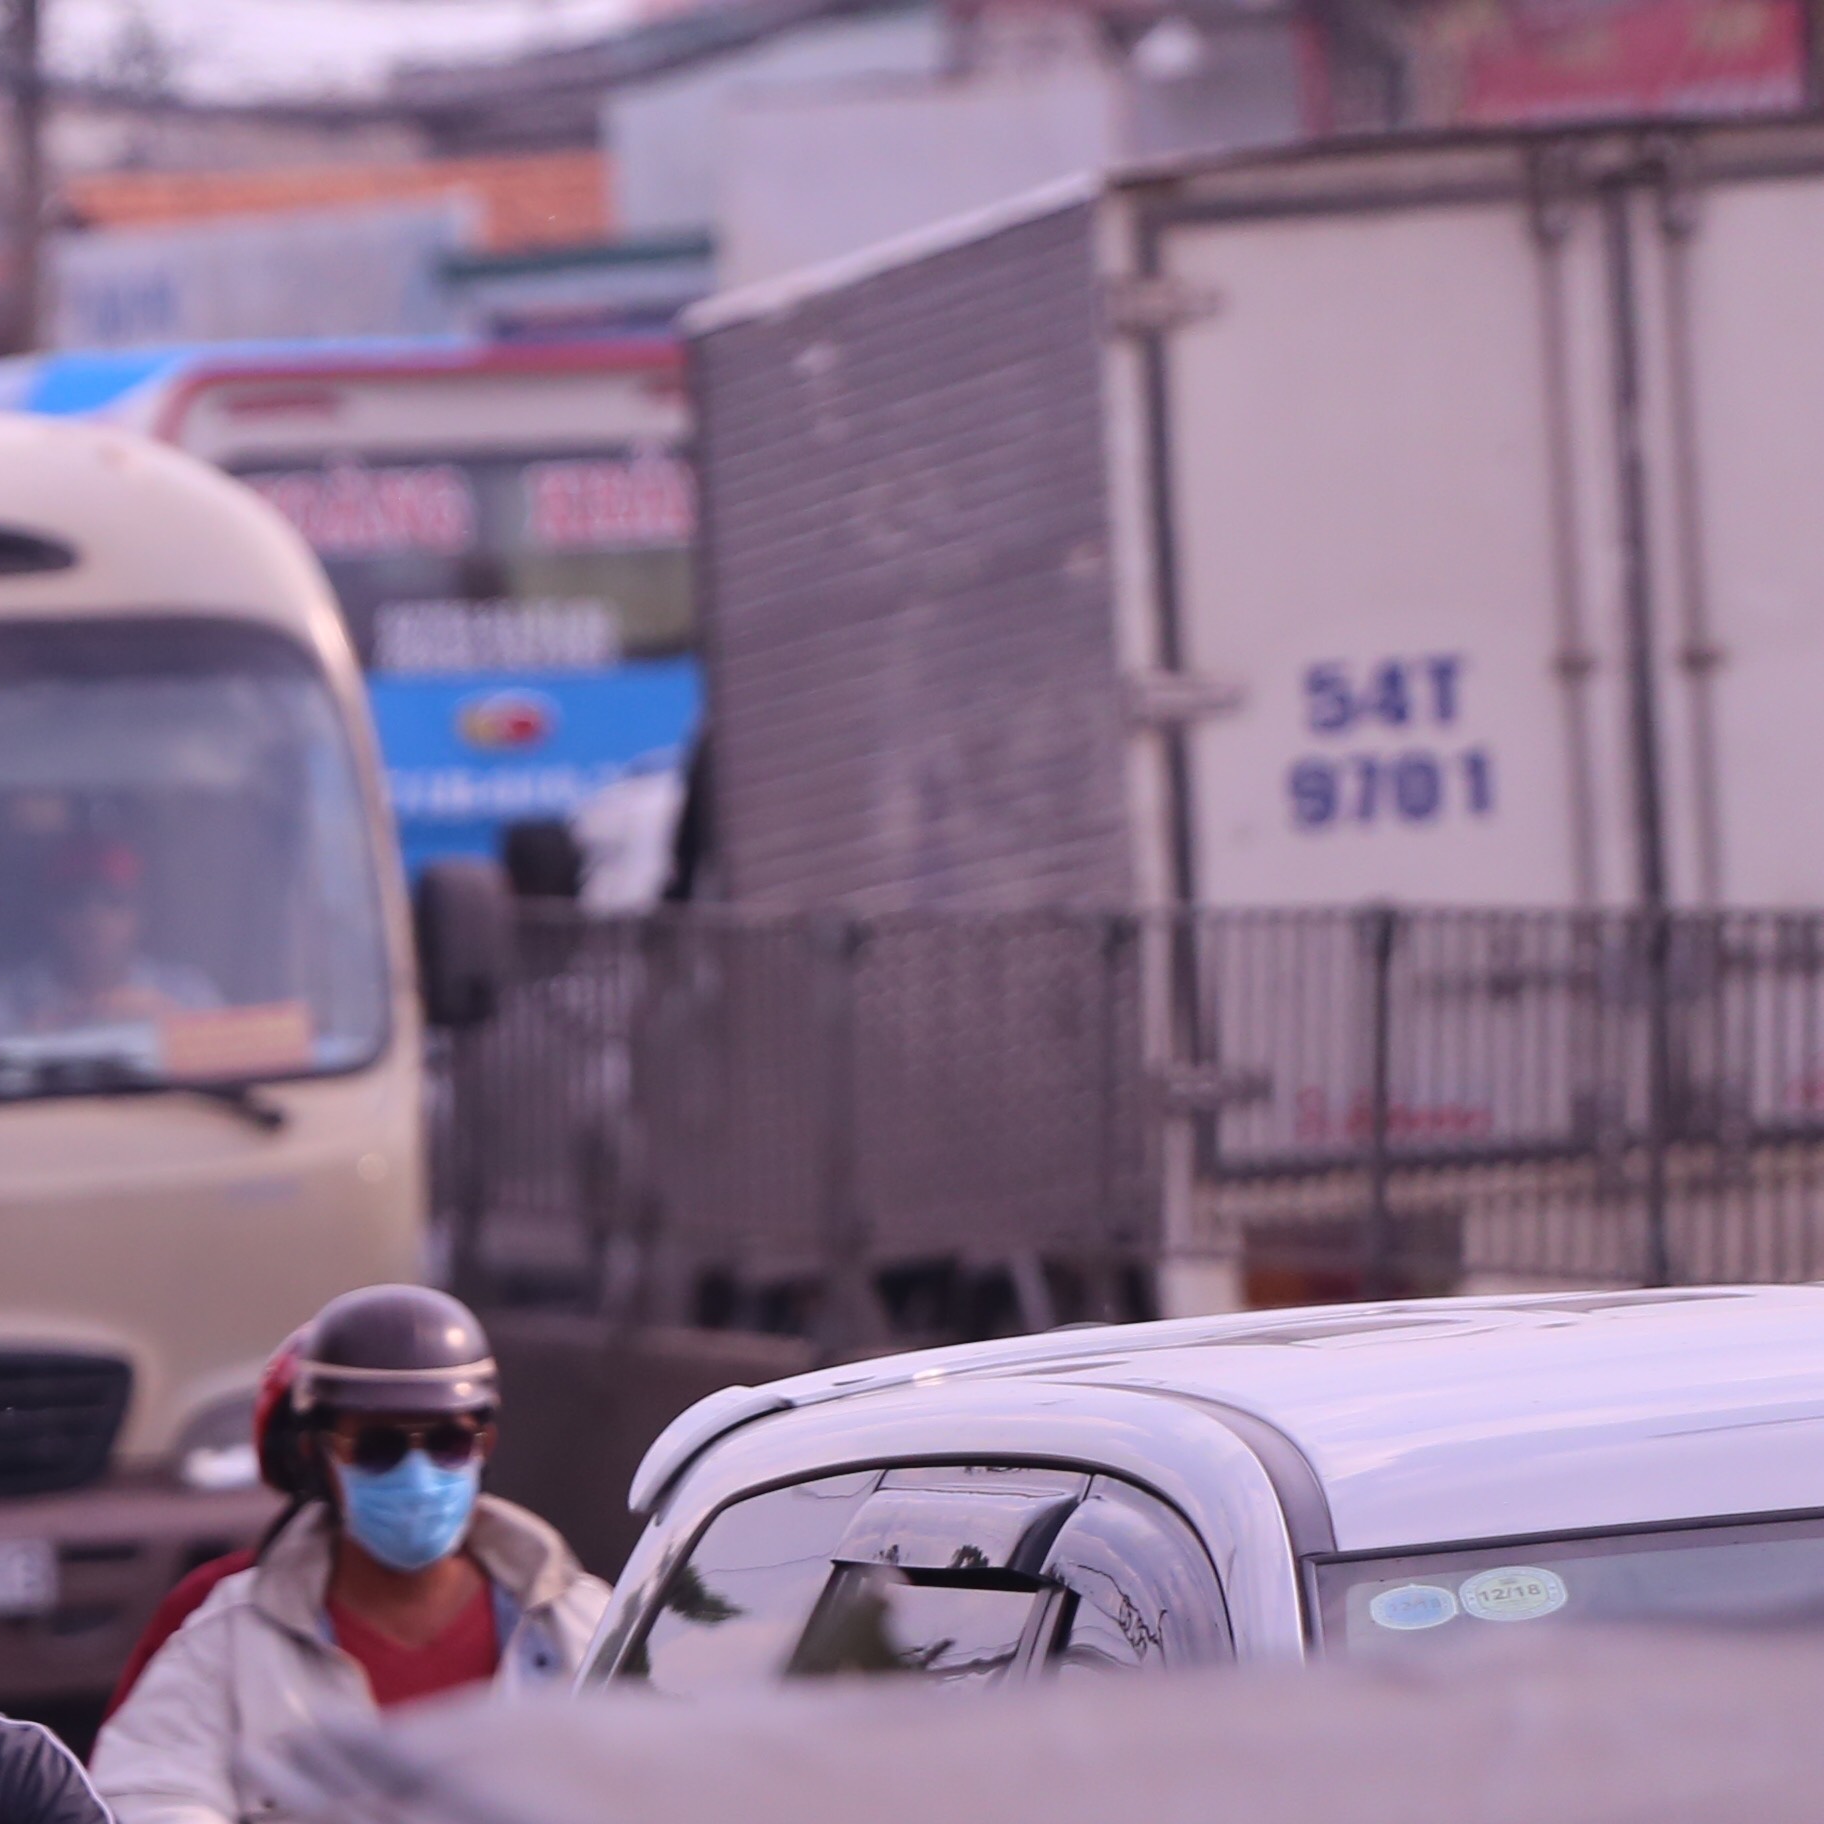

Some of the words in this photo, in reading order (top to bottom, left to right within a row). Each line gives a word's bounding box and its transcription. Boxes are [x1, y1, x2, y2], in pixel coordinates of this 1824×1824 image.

[1300, 655, 1466, 732] 54T
[1288, 748, 1494, 828] 9701
[1478, 1583, 1542, 1602] 12/18
